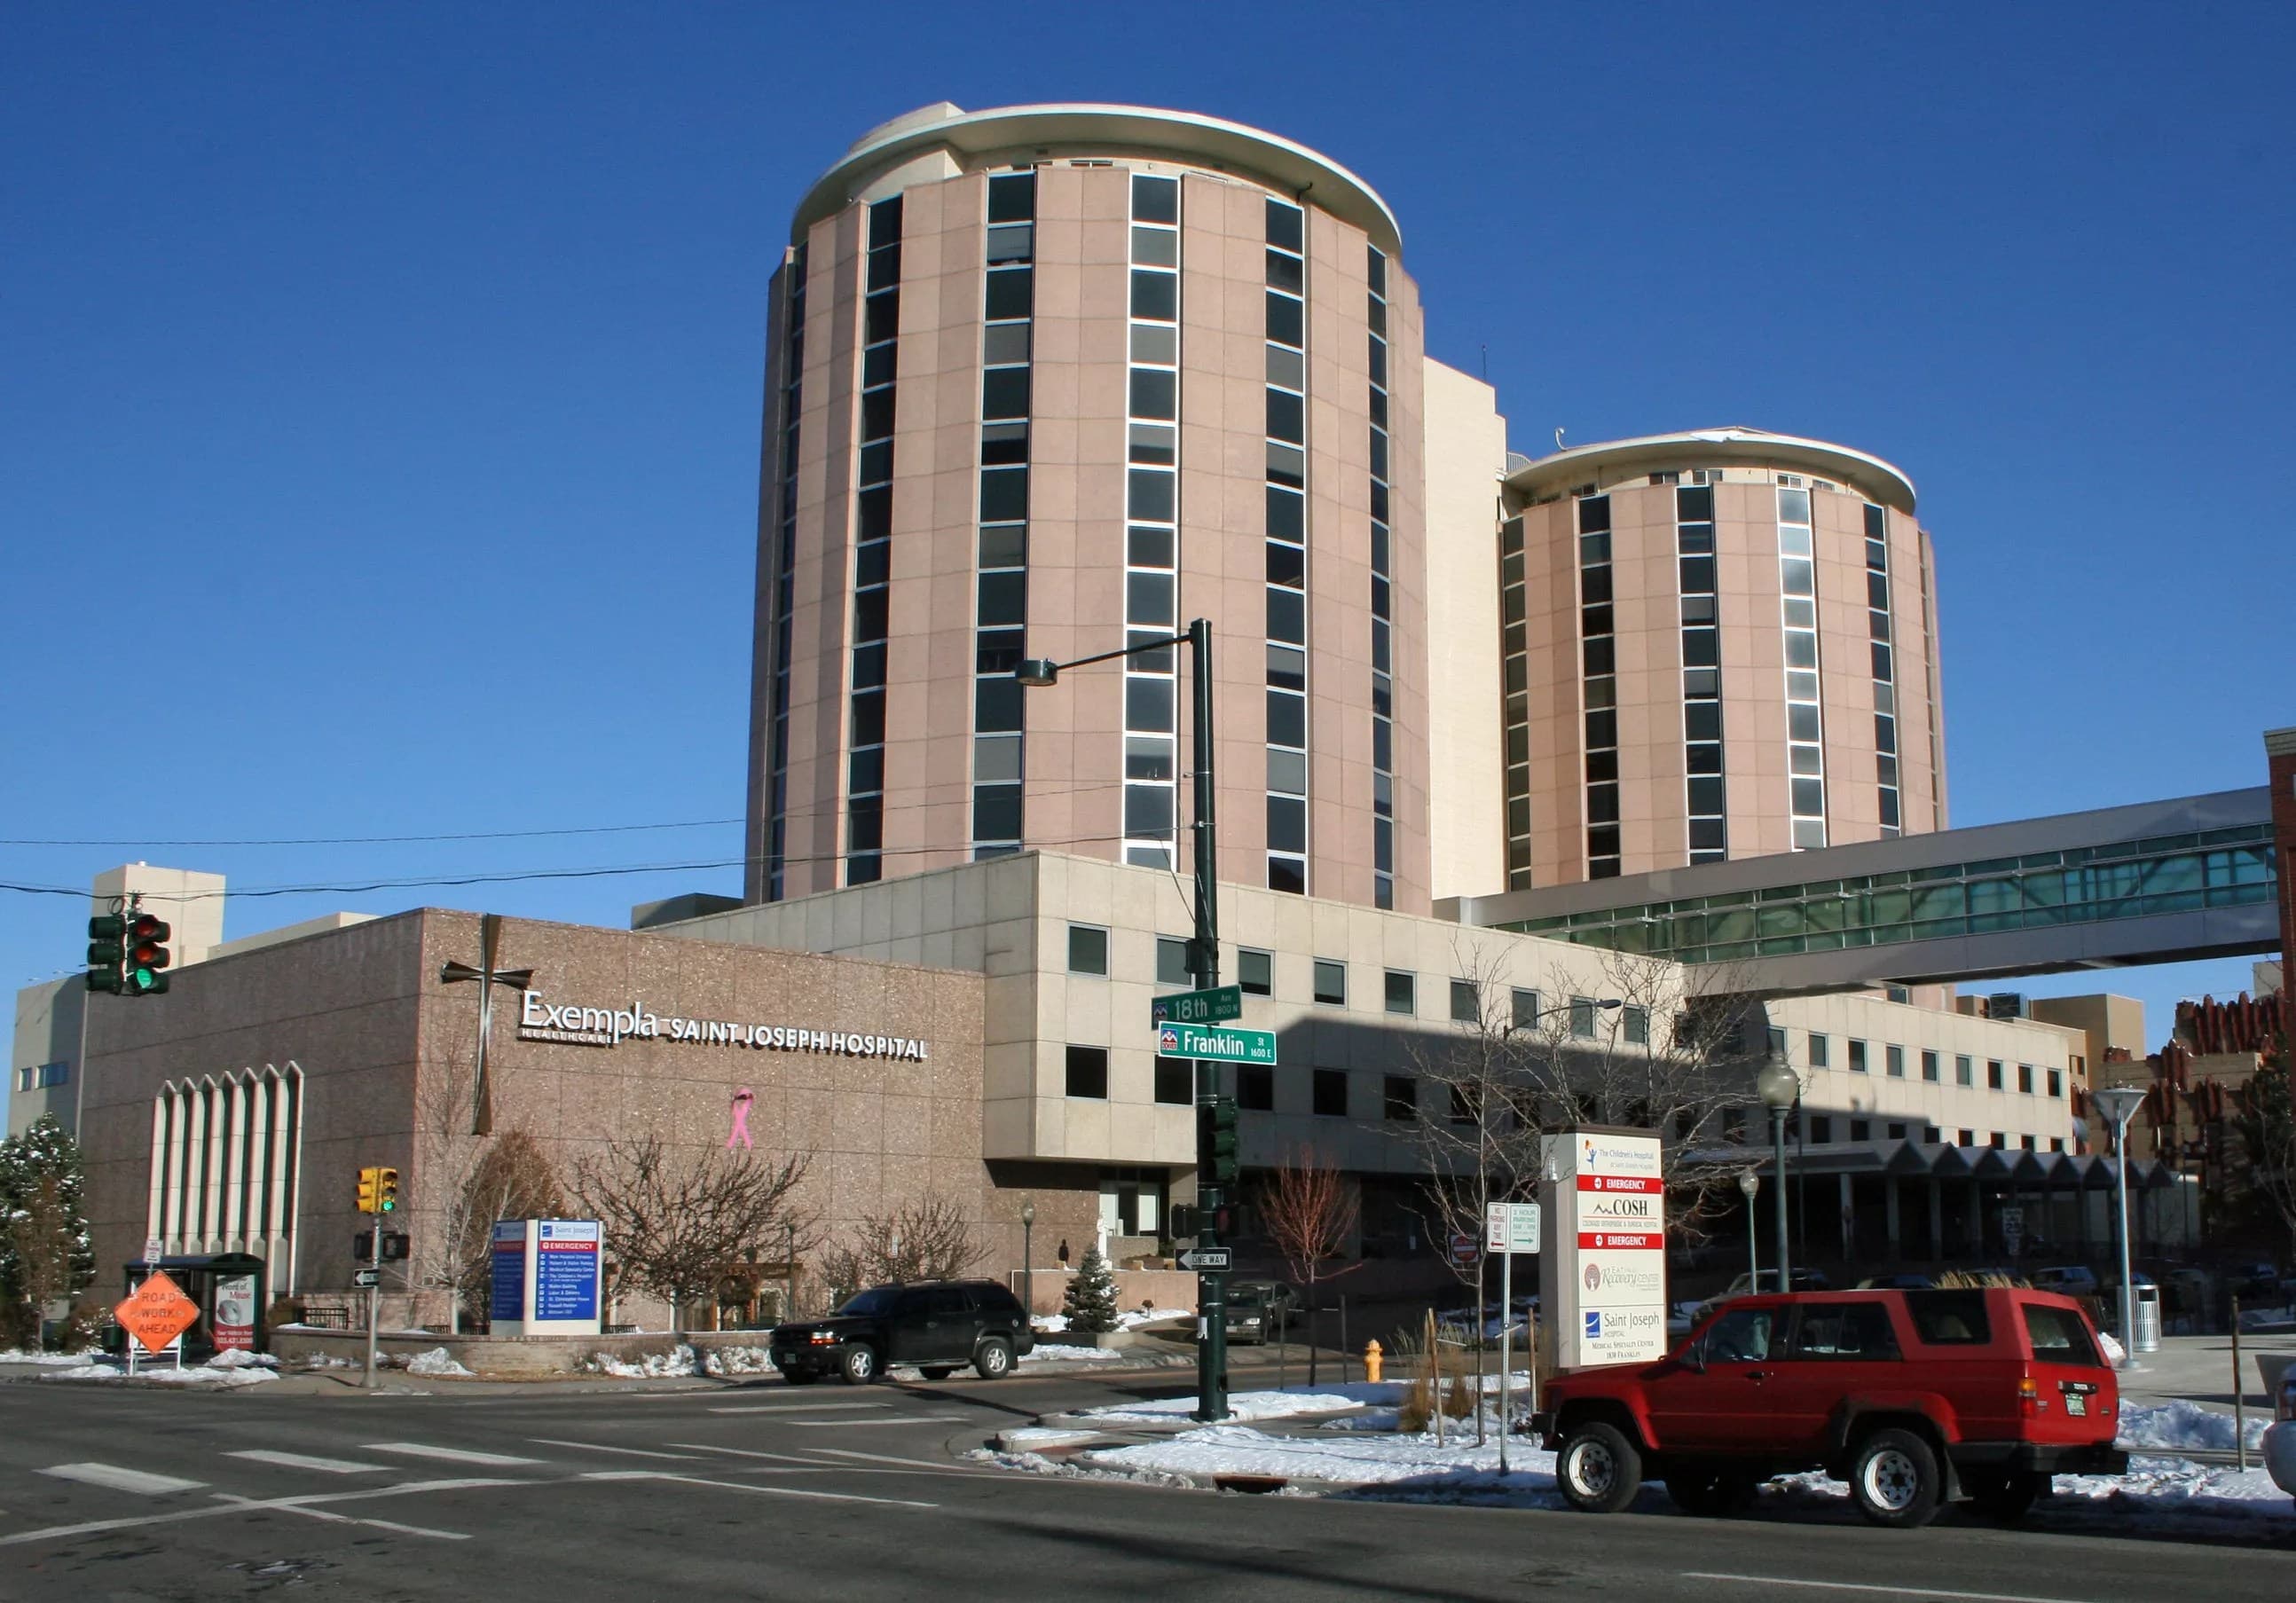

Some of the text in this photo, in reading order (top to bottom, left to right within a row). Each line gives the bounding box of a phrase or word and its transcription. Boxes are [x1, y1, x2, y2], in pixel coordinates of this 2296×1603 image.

[1175, 998, 1207, 1020] 18th
[522, 989, 929, 1058] Exempla SAINT JOSEPH HOSPITAL
[521, 1027, 613, 1045] HEALTHCARE
[1184, 1031, 1245, 1056] Franklin
[1257, 1037, 1264, 1046] St
[1251, 1048, 1266, 1057] 1600
[1606, 1178, 1646, 1190] EMERGENCY
[1613, 1198, 1648, 1215] COSH
[1607, 1236, 1647, 1246] EMERGENCY
[1192, 1255, 1225, 1264] ONE WAY
[141, 1292, 177, 1303] ROAD
[141, 1308, 175, 1318] WORK
[1604, 1311, 1660, 1329] Saint Joseph
[138, 1324, 177, 1334] AHEAD
